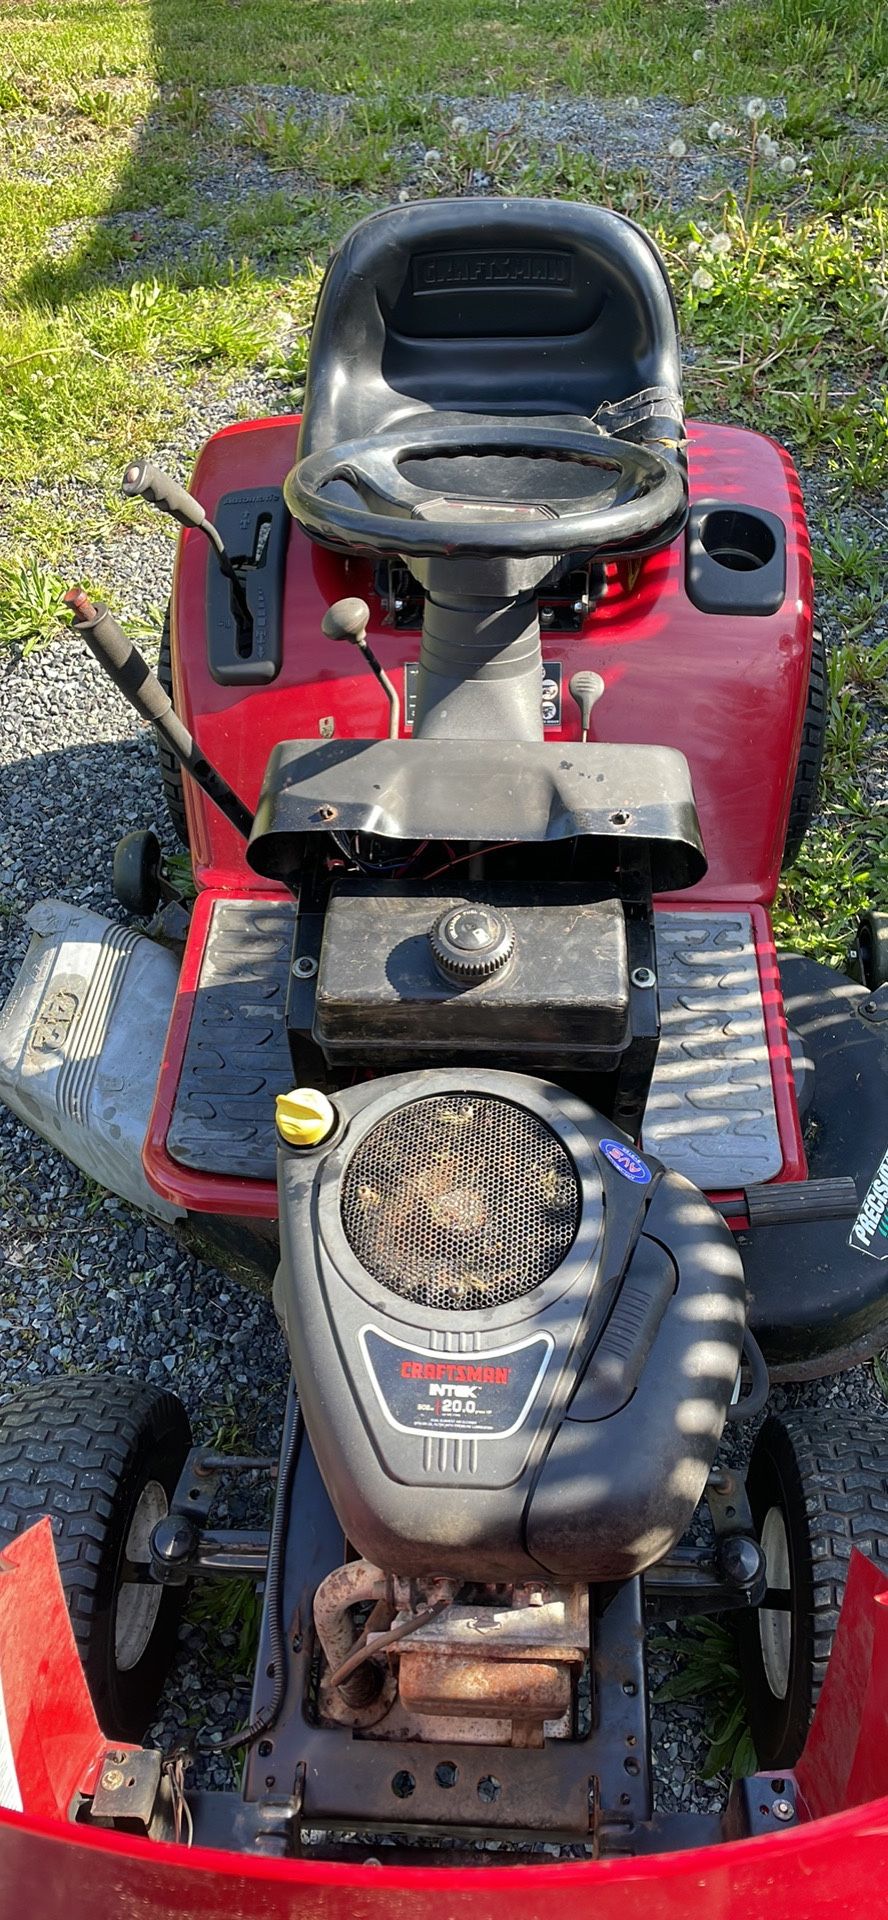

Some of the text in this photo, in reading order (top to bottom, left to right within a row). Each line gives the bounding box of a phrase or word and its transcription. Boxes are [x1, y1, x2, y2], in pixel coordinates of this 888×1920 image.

[425, 256, 565, 283] CRAFTSMAN
[609, 1147, 641, 1173] AVS
[400, 1361, 510, 1385] CRAFTSMAN
[440, 1399, 476, 1415] 20.0
